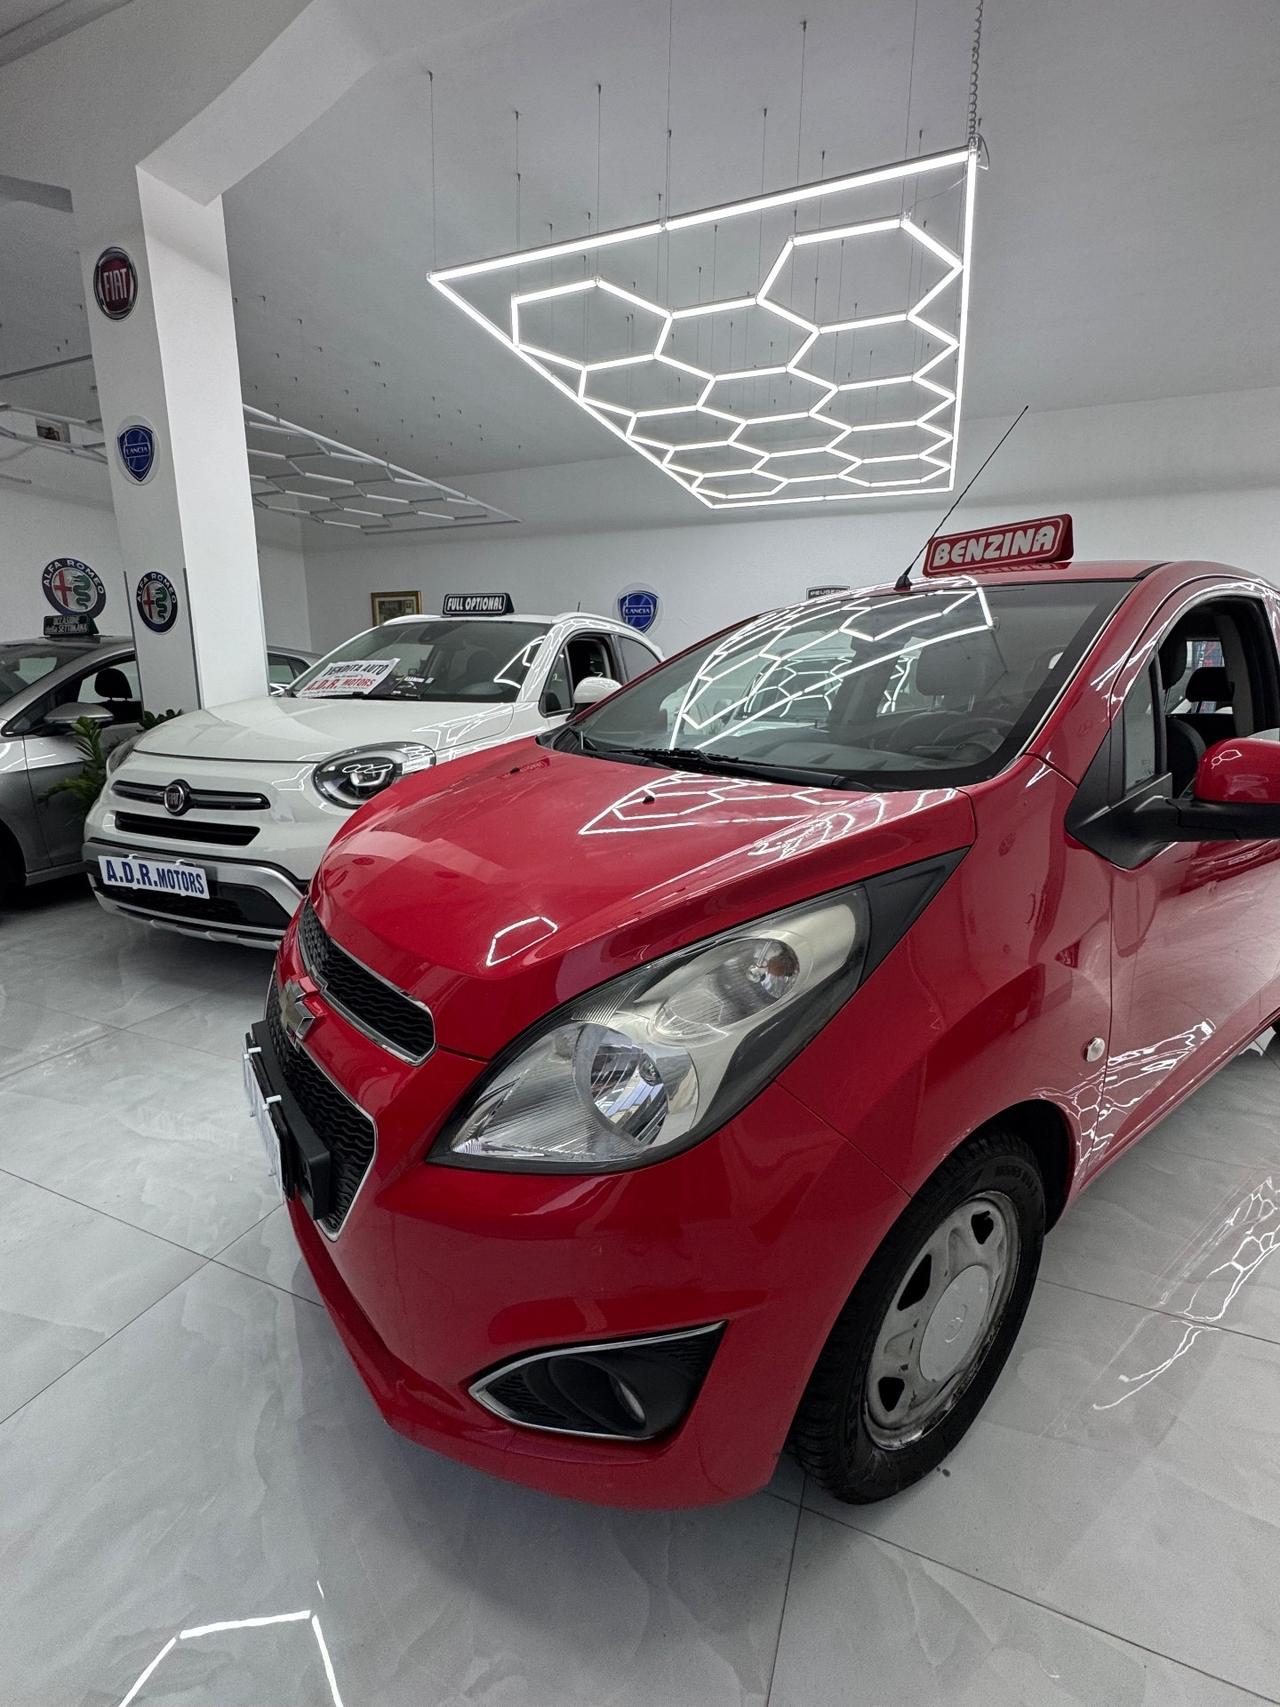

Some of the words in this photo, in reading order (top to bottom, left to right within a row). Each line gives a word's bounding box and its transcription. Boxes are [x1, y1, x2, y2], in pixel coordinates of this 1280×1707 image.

[103, 268, 129, 301] FIAT
[126, 447, 149, 455] LANCIA
[933, 525, 1056, 567] BENZINA
[43, 561, 62, 587] ALFA
[67, 560, 104, 594] ROMEO
[137, 577, 149, 603] ALFA
[151, 572, 177, 604] ROMEO
[446, 597, 463, 611] FULL
[465, 596, 503, 611] OPTIONAL
[323, 665, 363, 676] VENDITA
[363, 663, 389, 675] AUTO
[343, 678, 376, 688] MOTORS
